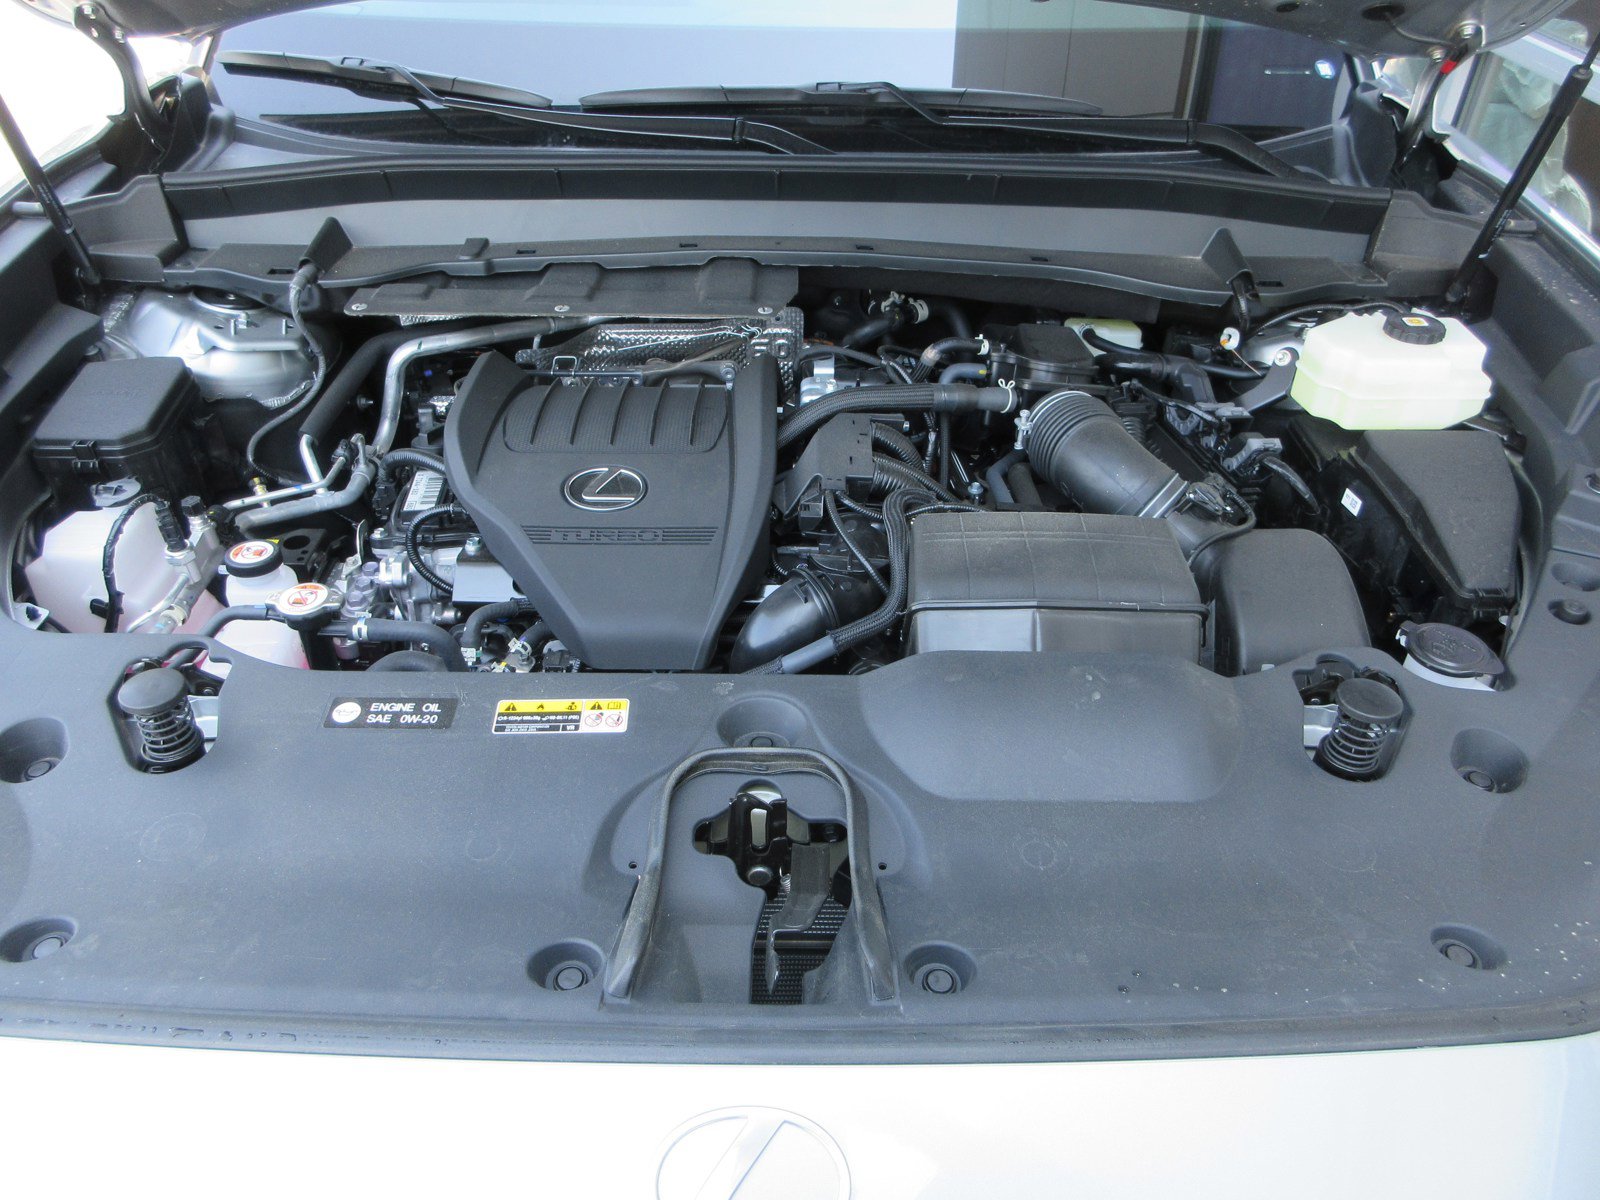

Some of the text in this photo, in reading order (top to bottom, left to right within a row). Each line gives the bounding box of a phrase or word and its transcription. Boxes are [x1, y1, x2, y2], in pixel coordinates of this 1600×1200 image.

[553, 529, 661, 542] TURBO
[369, 702, 442, 713] ENGINE OIL
[366, 713, 439, 724] SAE 0W-20
